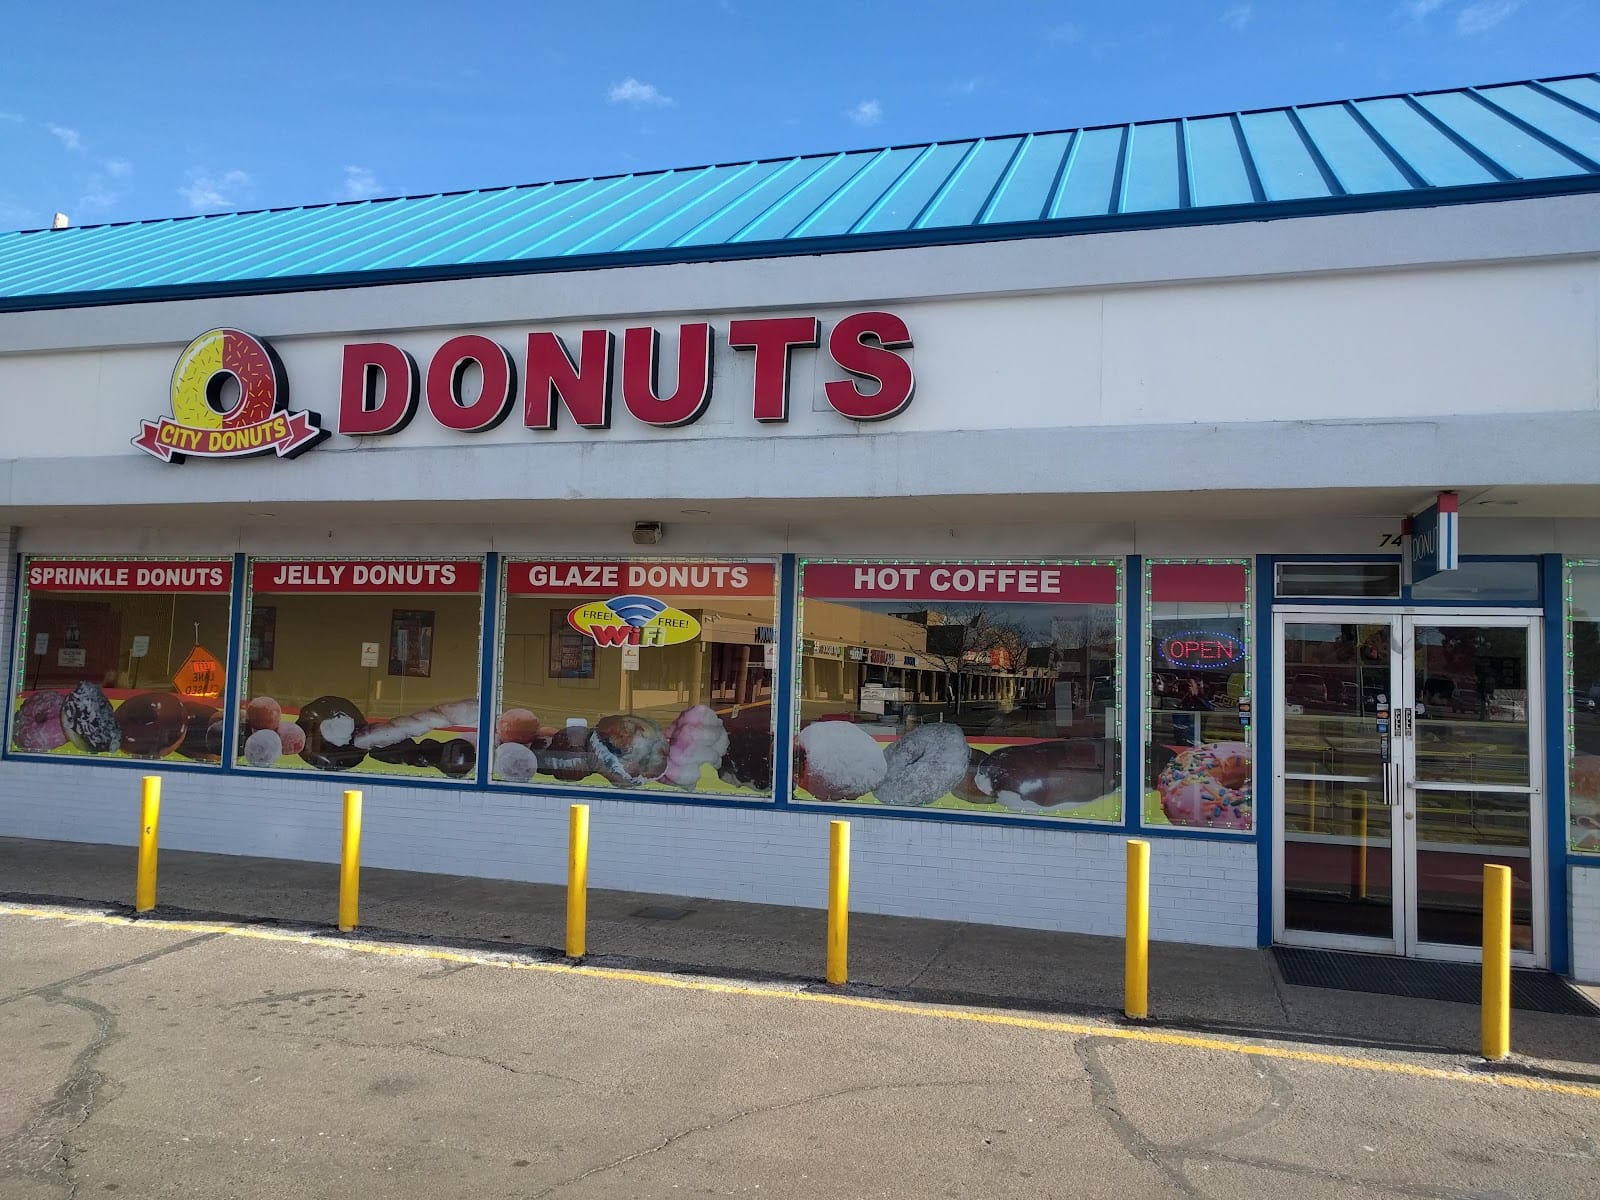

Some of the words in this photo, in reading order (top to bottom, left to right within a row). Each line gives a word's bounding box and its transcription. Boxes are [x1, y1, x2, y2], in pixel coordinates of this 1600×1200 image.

[339, 312, 915, 436] DONUTS
[160, 423, 203, 450] CITY
[208, 417, 287, 452] DONUTS
[1412, 526, 1438, 562] DONU
[30, 567, 129, 586] SPRINKLE
[136, 568, 223, 586] DONUTS
[273, 565, 346, 585] JELLY
[352, 564, 456, 585] DONUTS
[528, 565, 619, 587] GLAZE
[628, 566, 749, 589] DONUTS
[854, 567, 921, 591] HOT
[929, 569, 1061, 594] COFFEE
[583, 610, 613, 621] FREE!
[658, 617, 689, 629] FREE!
[1170, 640, 1233, 659] OPEN
